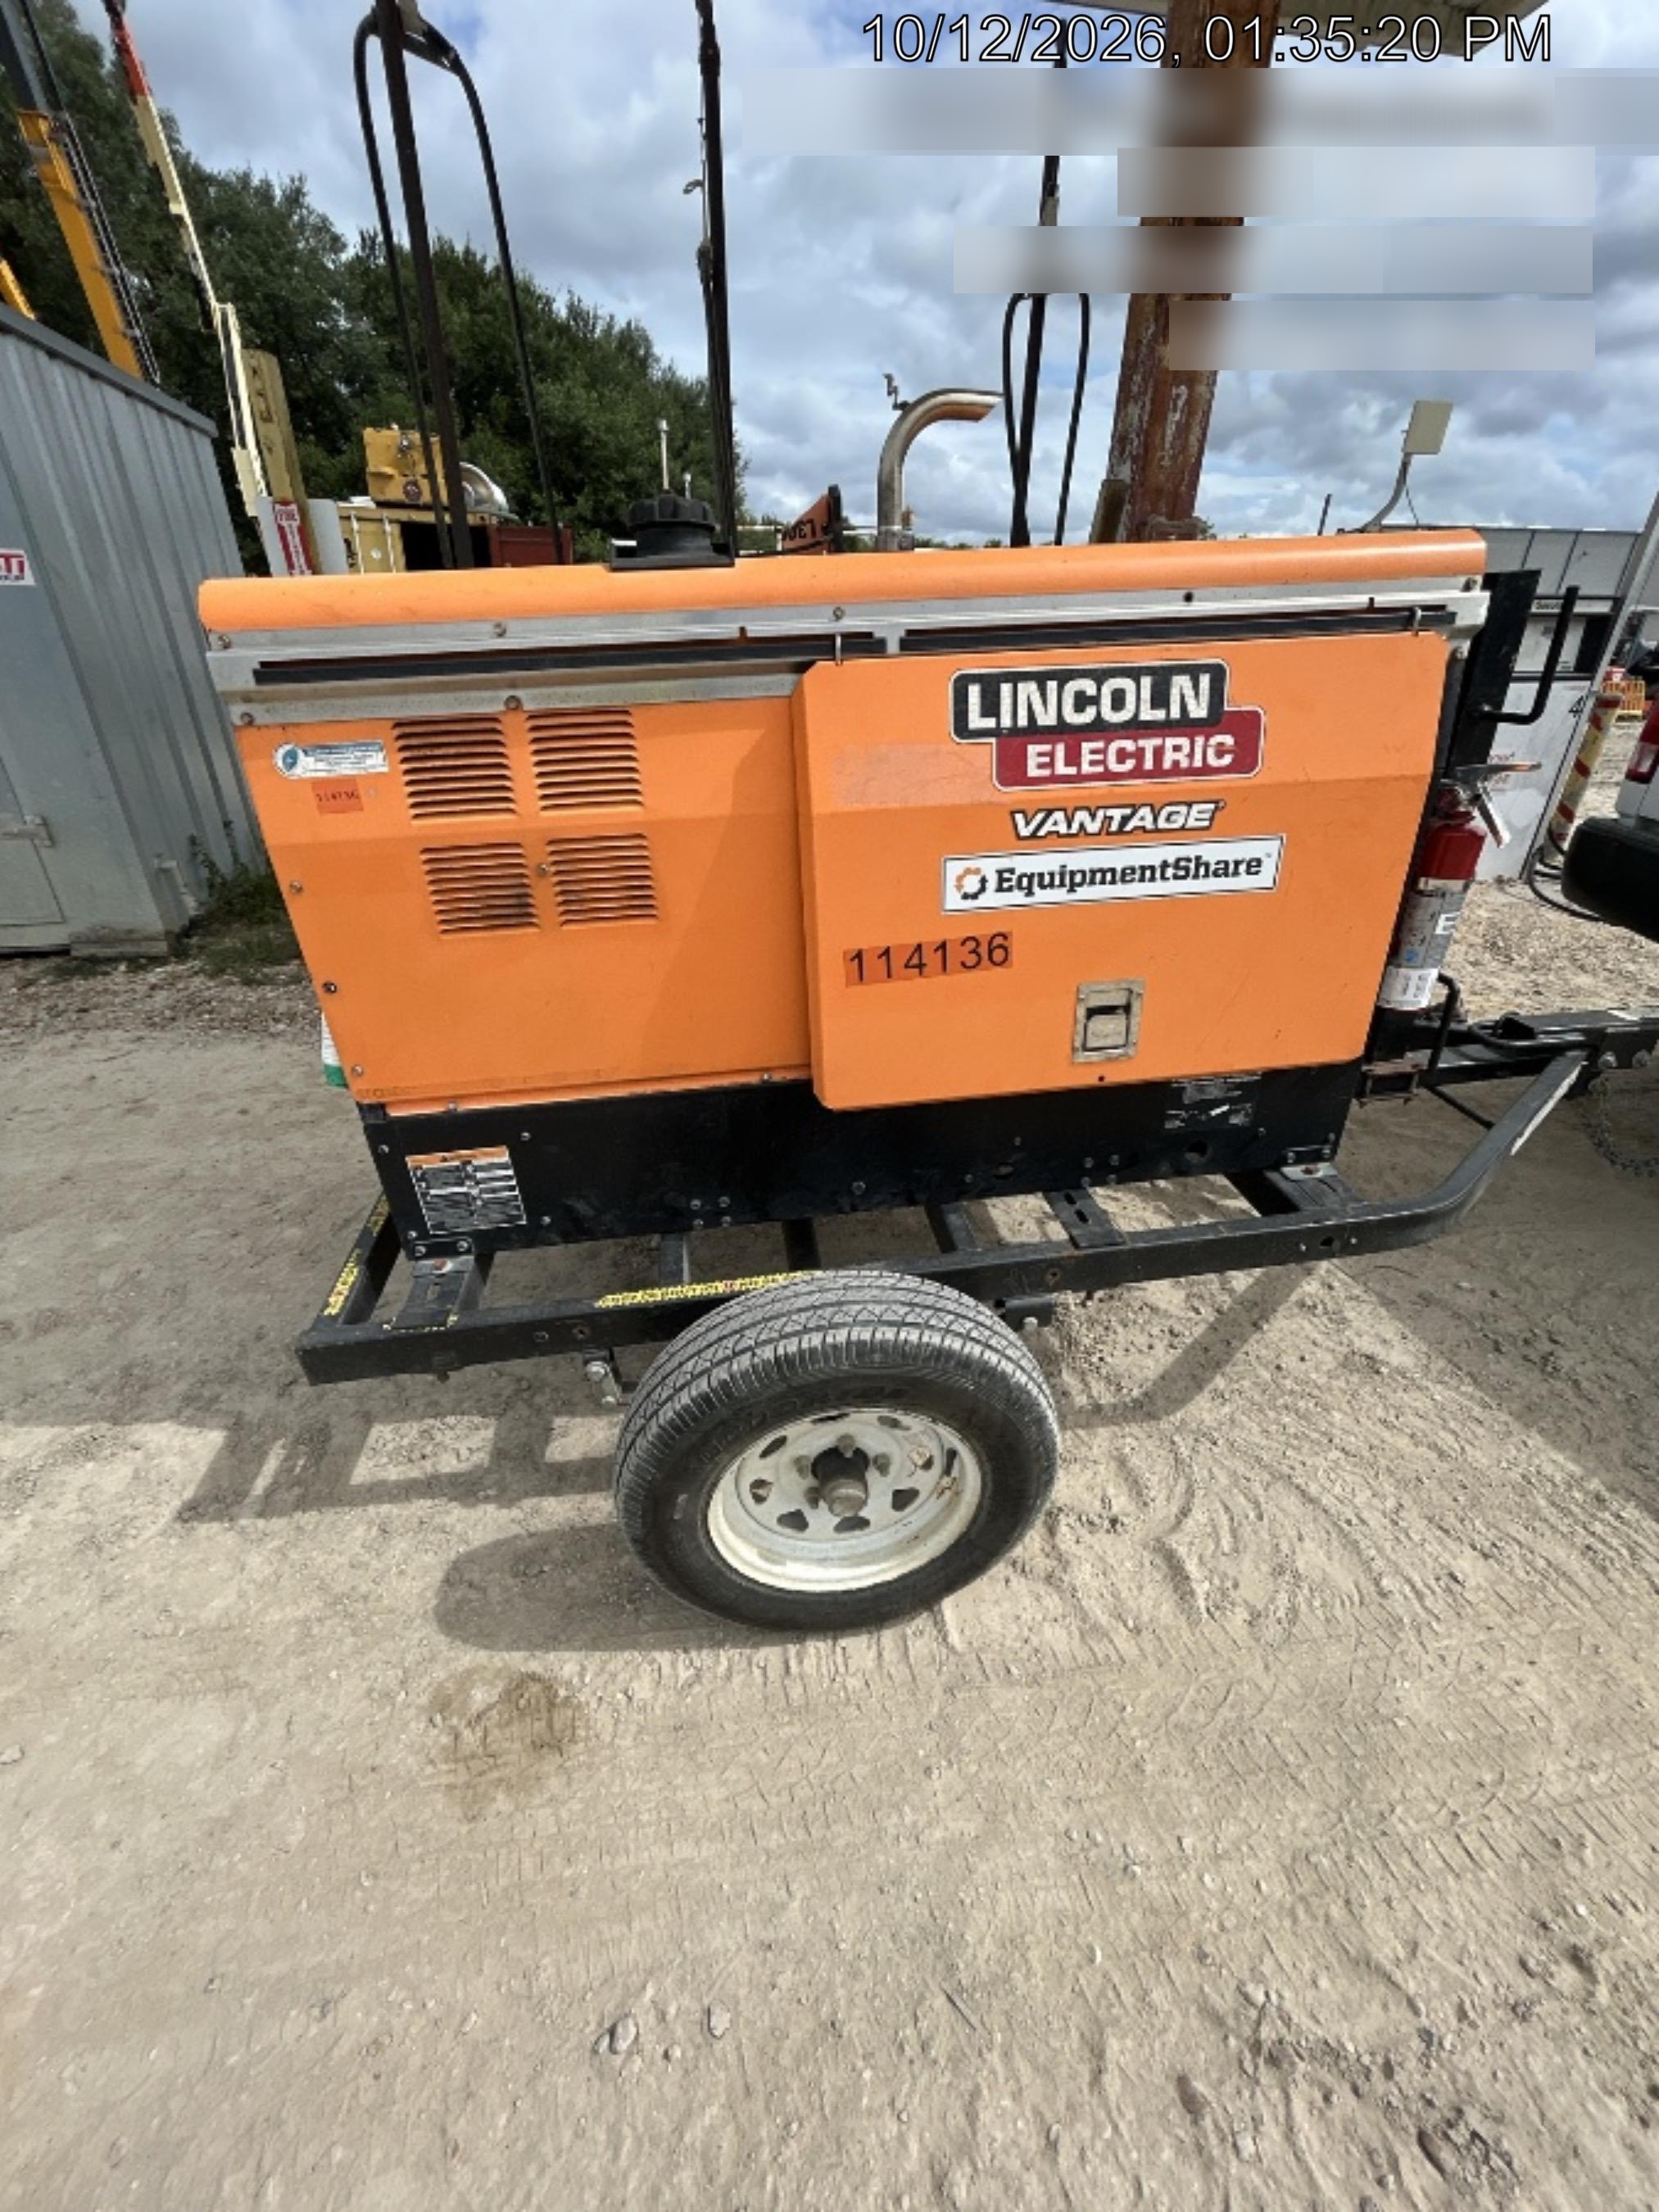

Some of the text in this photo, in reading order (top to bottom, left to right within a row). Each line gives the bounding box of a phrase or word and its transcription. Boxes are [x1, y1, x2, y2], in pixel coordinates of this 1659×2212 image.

[967, 672, 1212, 731] LINCOLN
[1026, 734, 1236, 779] ELECTRIC
[1011, 800, 1219, 839] VANTAGE
[994, 854, 1263, 898] EquipmentShare
[849, 931, 1010, 983] 114136
